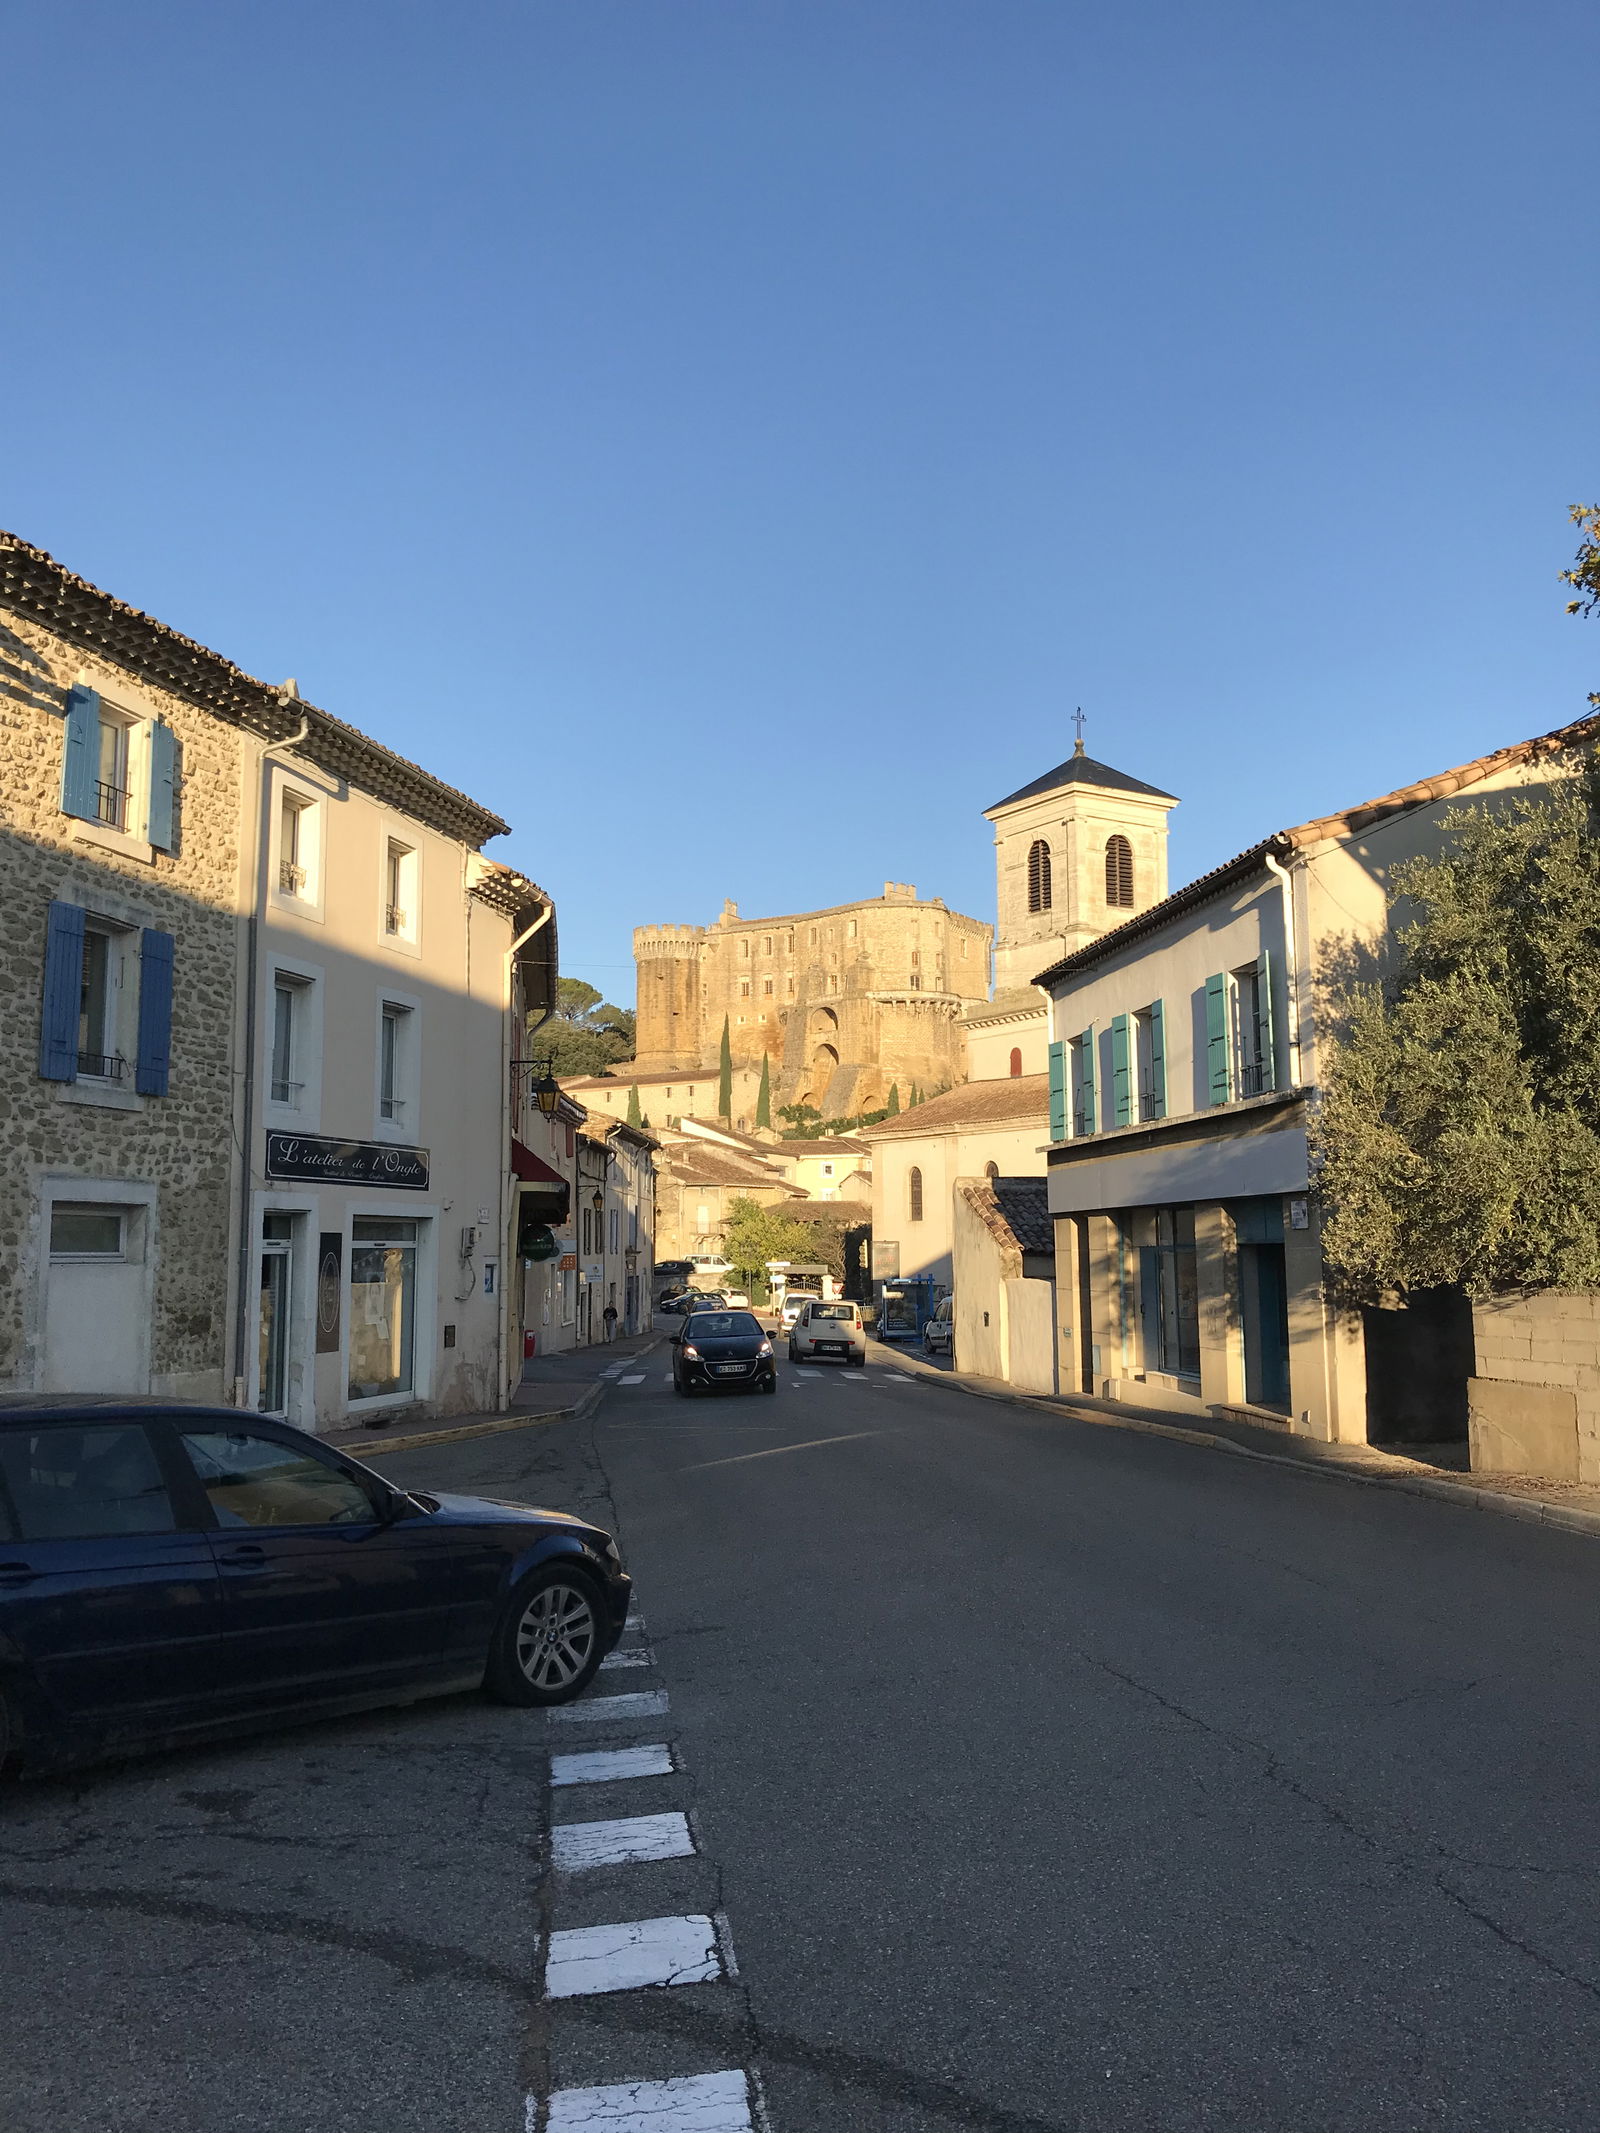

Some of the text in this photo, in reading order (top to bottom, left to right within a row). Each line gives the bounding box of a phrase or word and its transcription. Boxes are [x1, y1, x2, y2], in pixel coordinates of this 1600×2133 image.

[277, 1140, 344, 1167] L'atelier
[352, 1158, 365, 1170] de
[372, 1151, 421, 1177] l'Ongle
